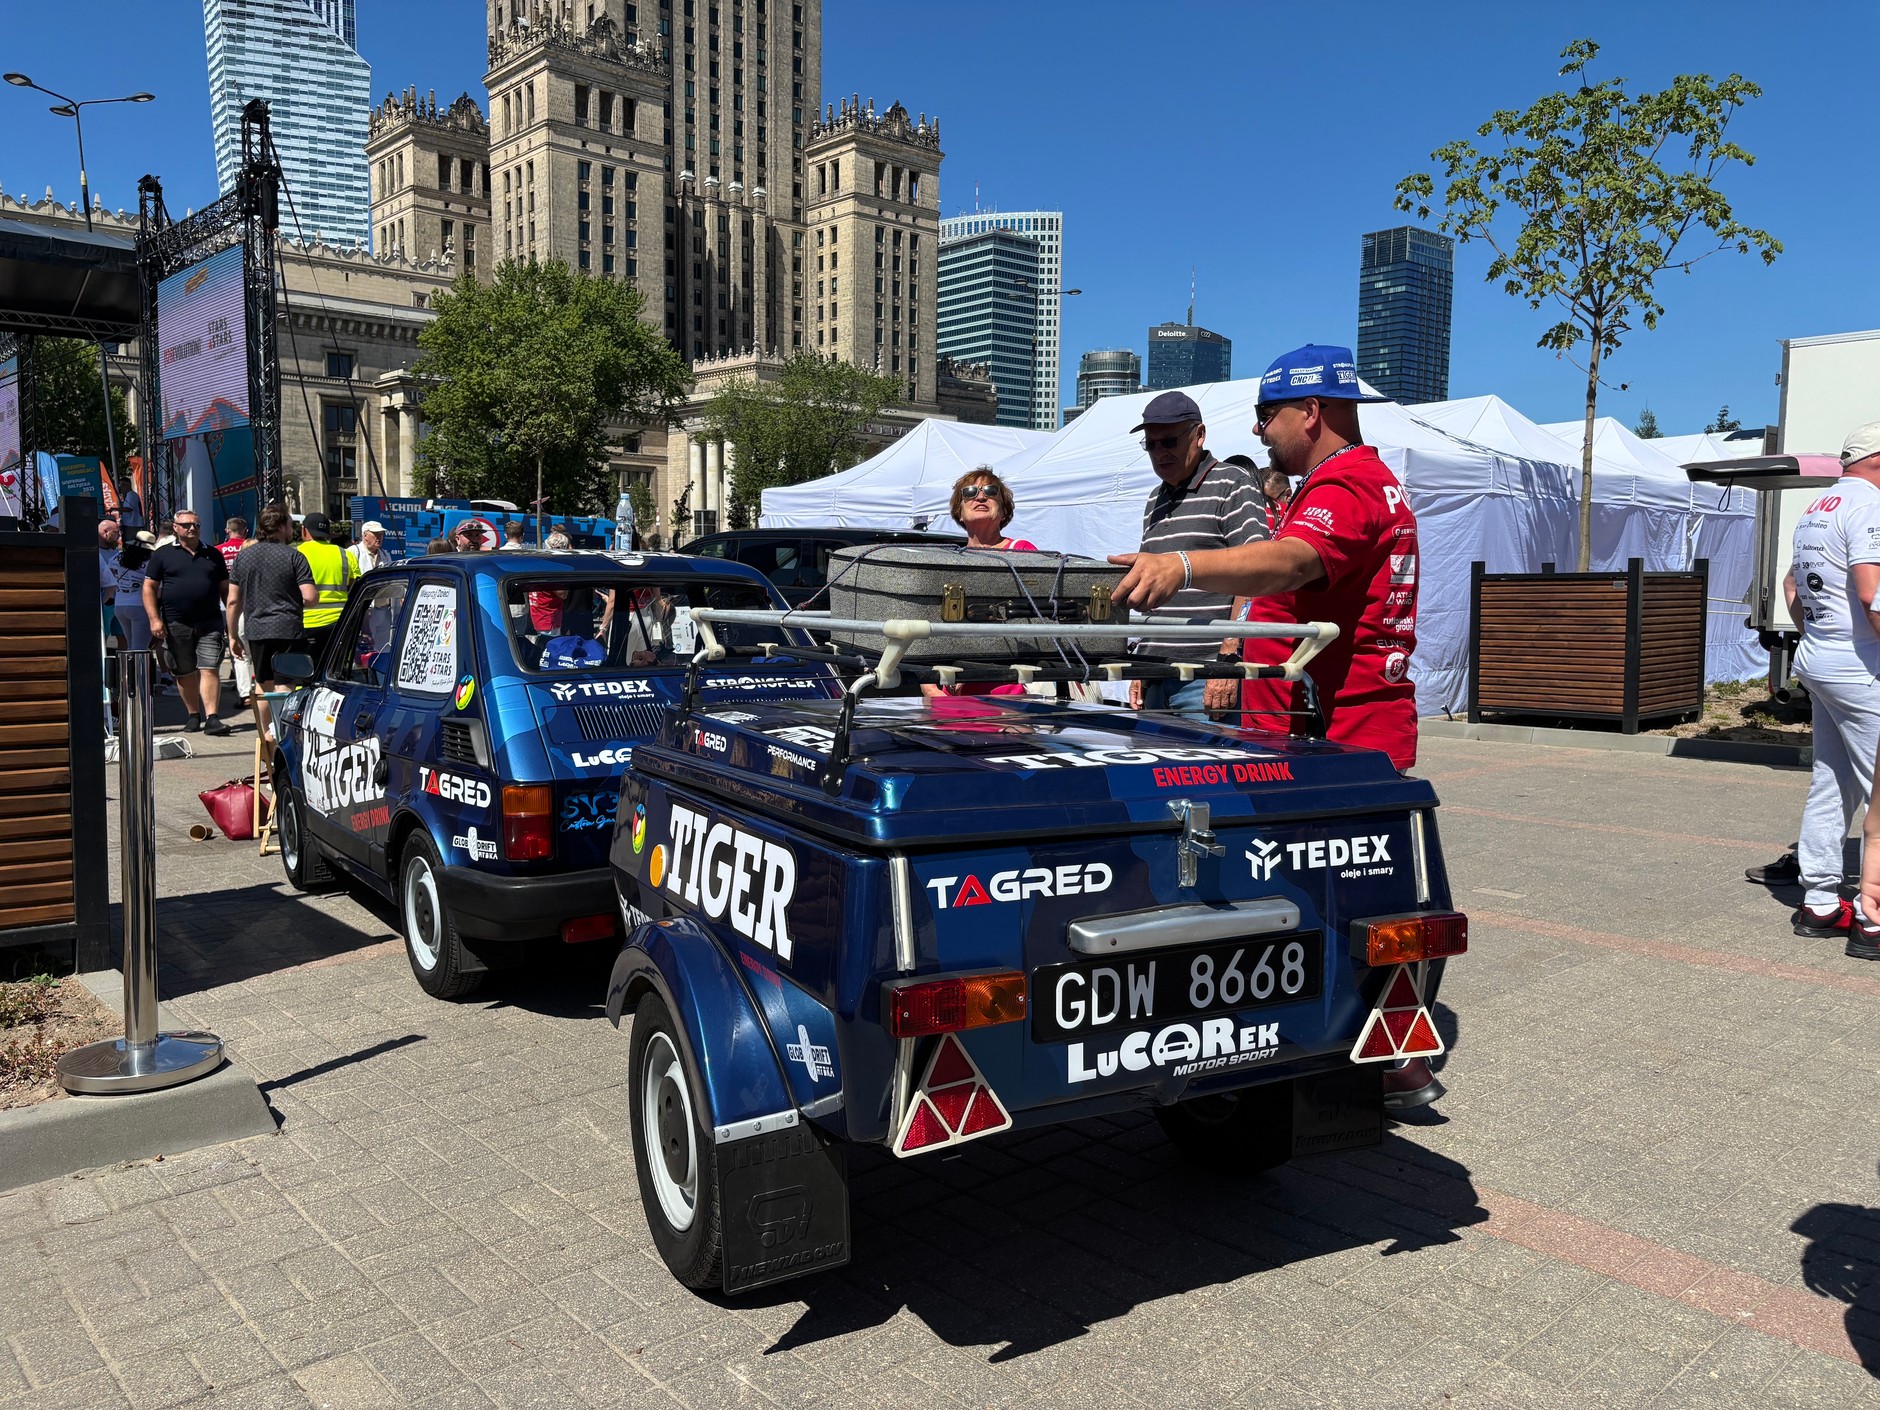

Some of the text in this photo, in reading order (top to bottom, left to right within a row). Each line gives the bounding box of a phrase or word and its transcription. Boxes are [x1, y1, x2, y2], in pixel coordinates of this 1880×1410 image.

[1395, 624, 1414, 632] group
[430, 664, 452, 676] 4STARS
[432, 652, 451, 664] STARS
[578, 680, 652, 697] TEDEX
[694, 729, 728, 752] TAGRED
[767, 745, 816, 771] PERFORMANCE
[317, 737, 387, 811] TIGER
[419, 766, 492, 808] TAGRED
[1152, 761, 1295, 788] ENERGY DRINK
[351, 804, 391, 832] ENERGY DRINK
[1286, 834, 1392, 870] TEDEX
[667, 803, 796, 961] TIGER
[926, 862, 1113, 909] TAGRED
[1341, 869, 1361, 879] oleje
[1368, 866, 1394, 876] smary
[1055, 941, 1305, 1030] GDW 8668
[1172, 1047, 1279, 1077] MOTOR SPORT
